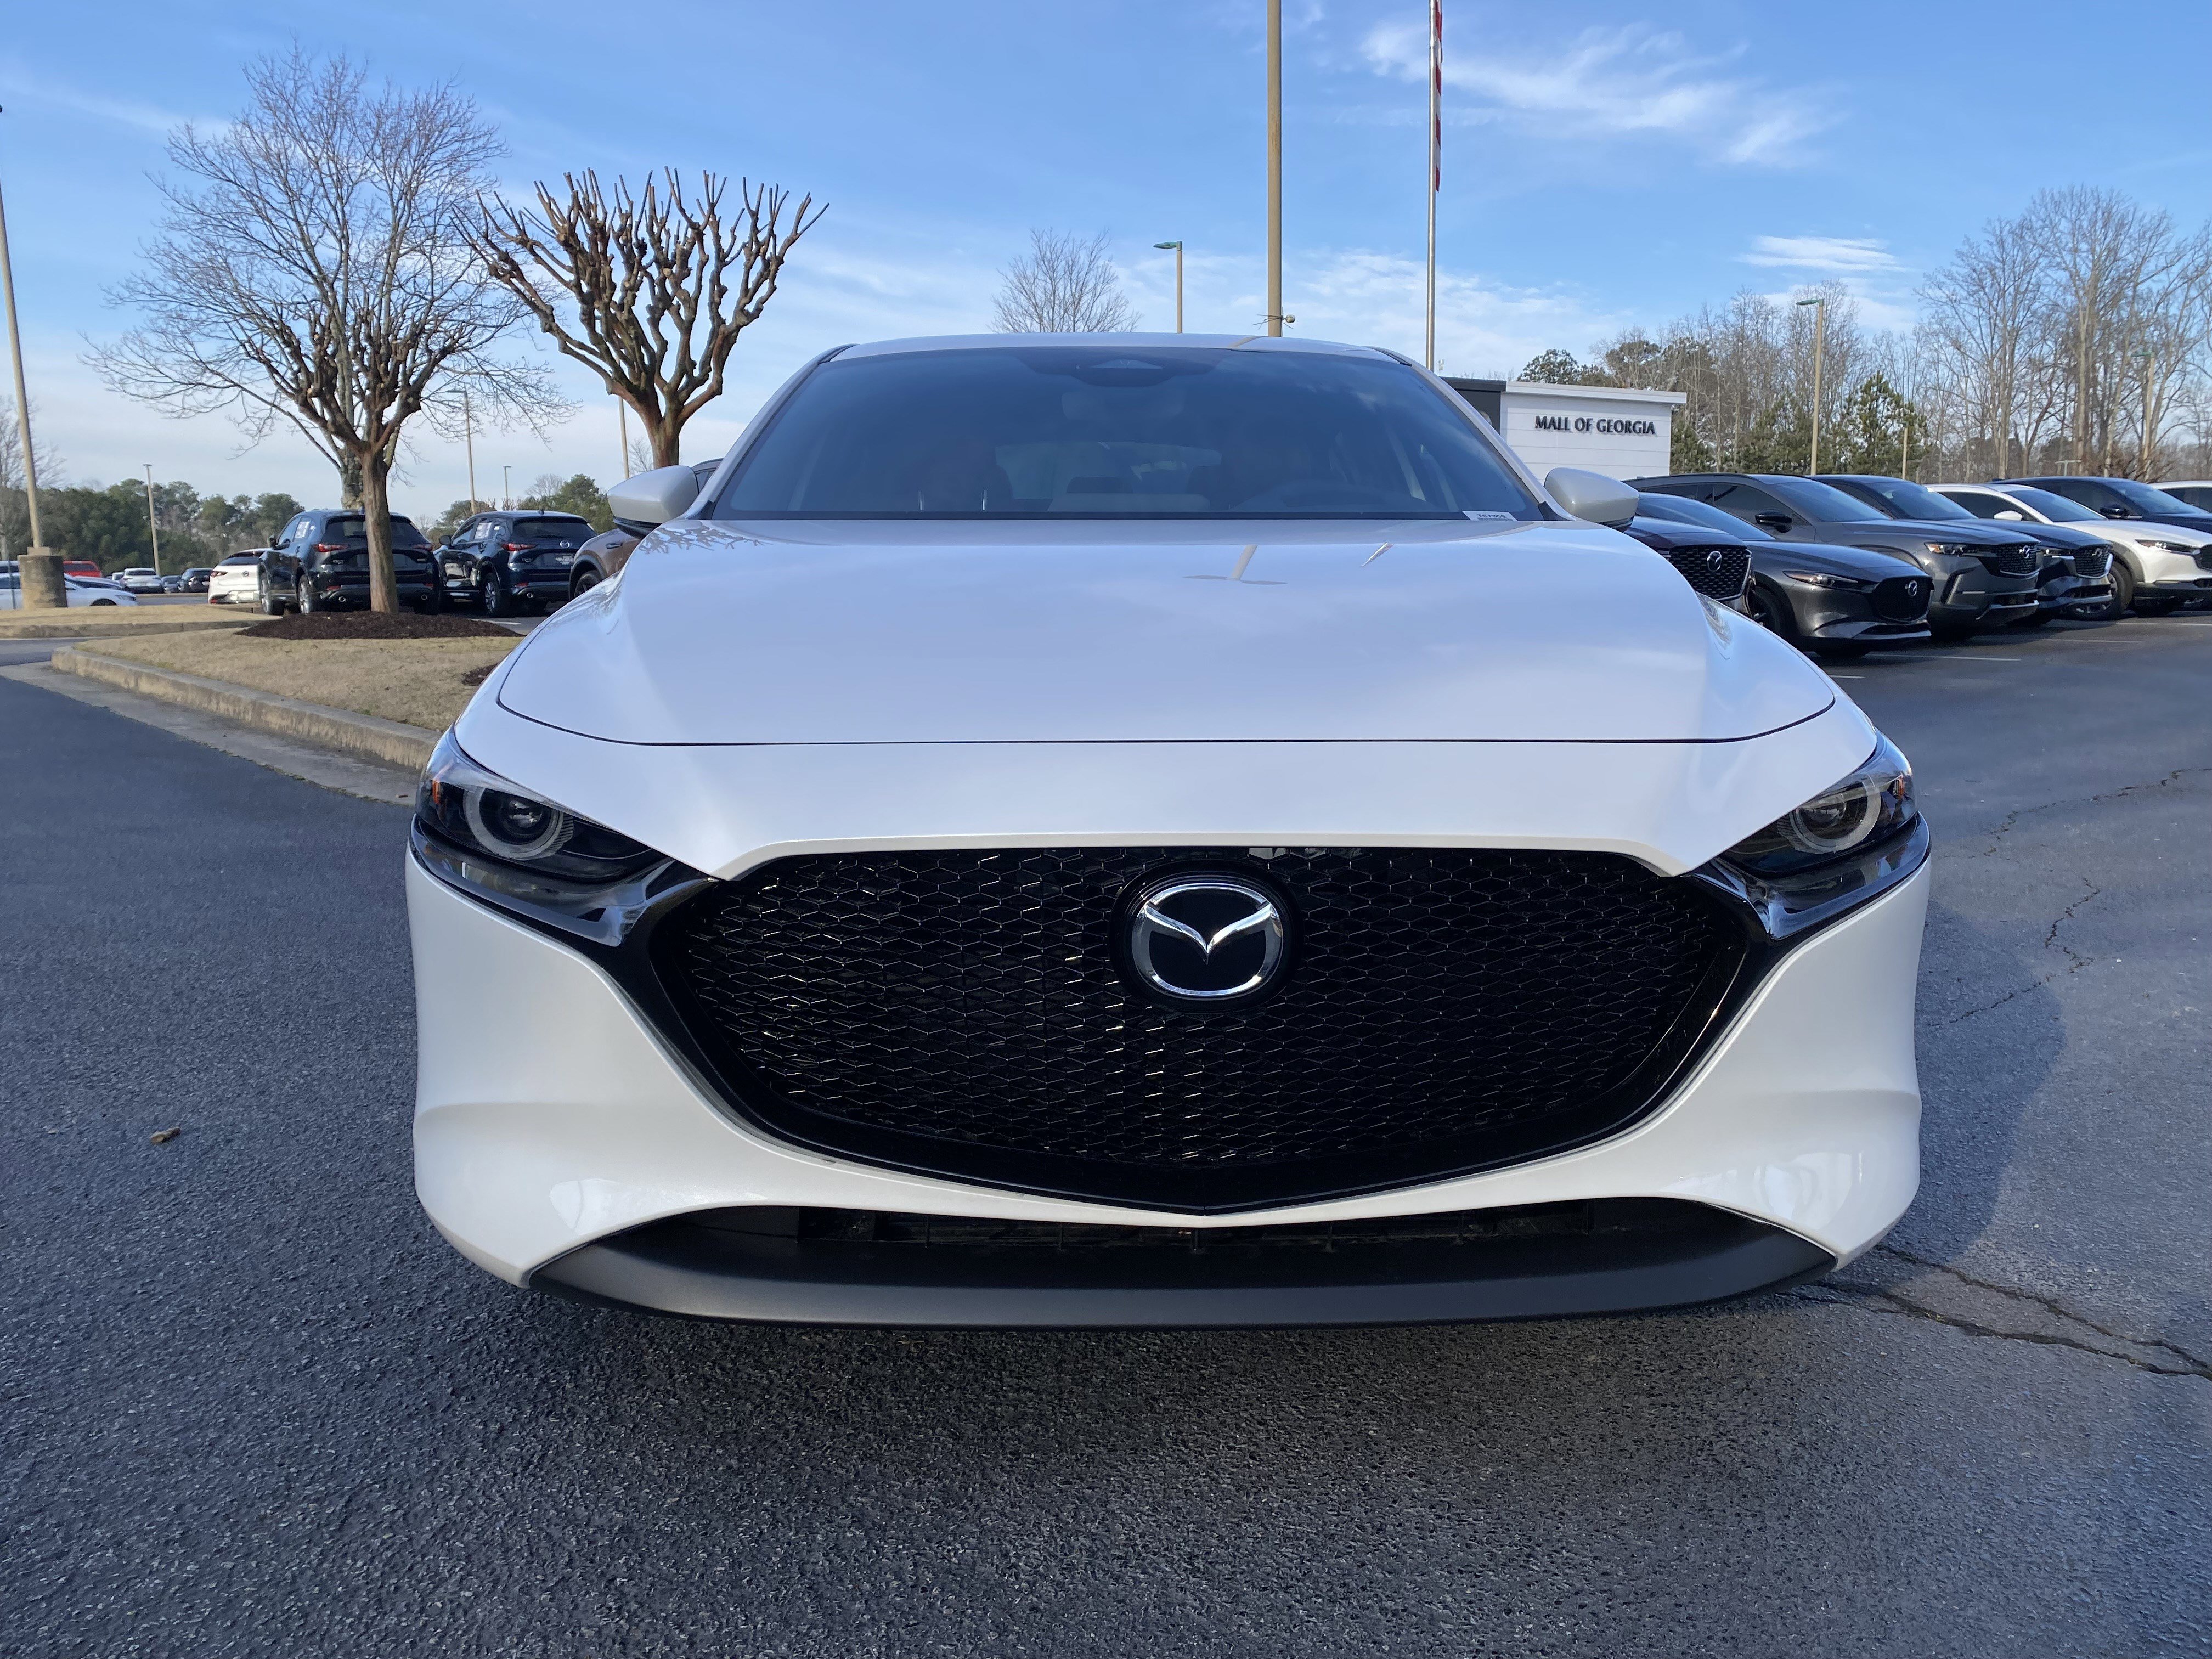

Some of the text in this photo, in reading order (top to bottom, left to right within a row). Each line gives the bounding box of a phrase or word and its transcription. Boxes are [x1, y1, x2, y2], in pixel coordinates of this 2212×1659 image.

[1535, 415, 1656, 435] MALL OF GEORGIA
